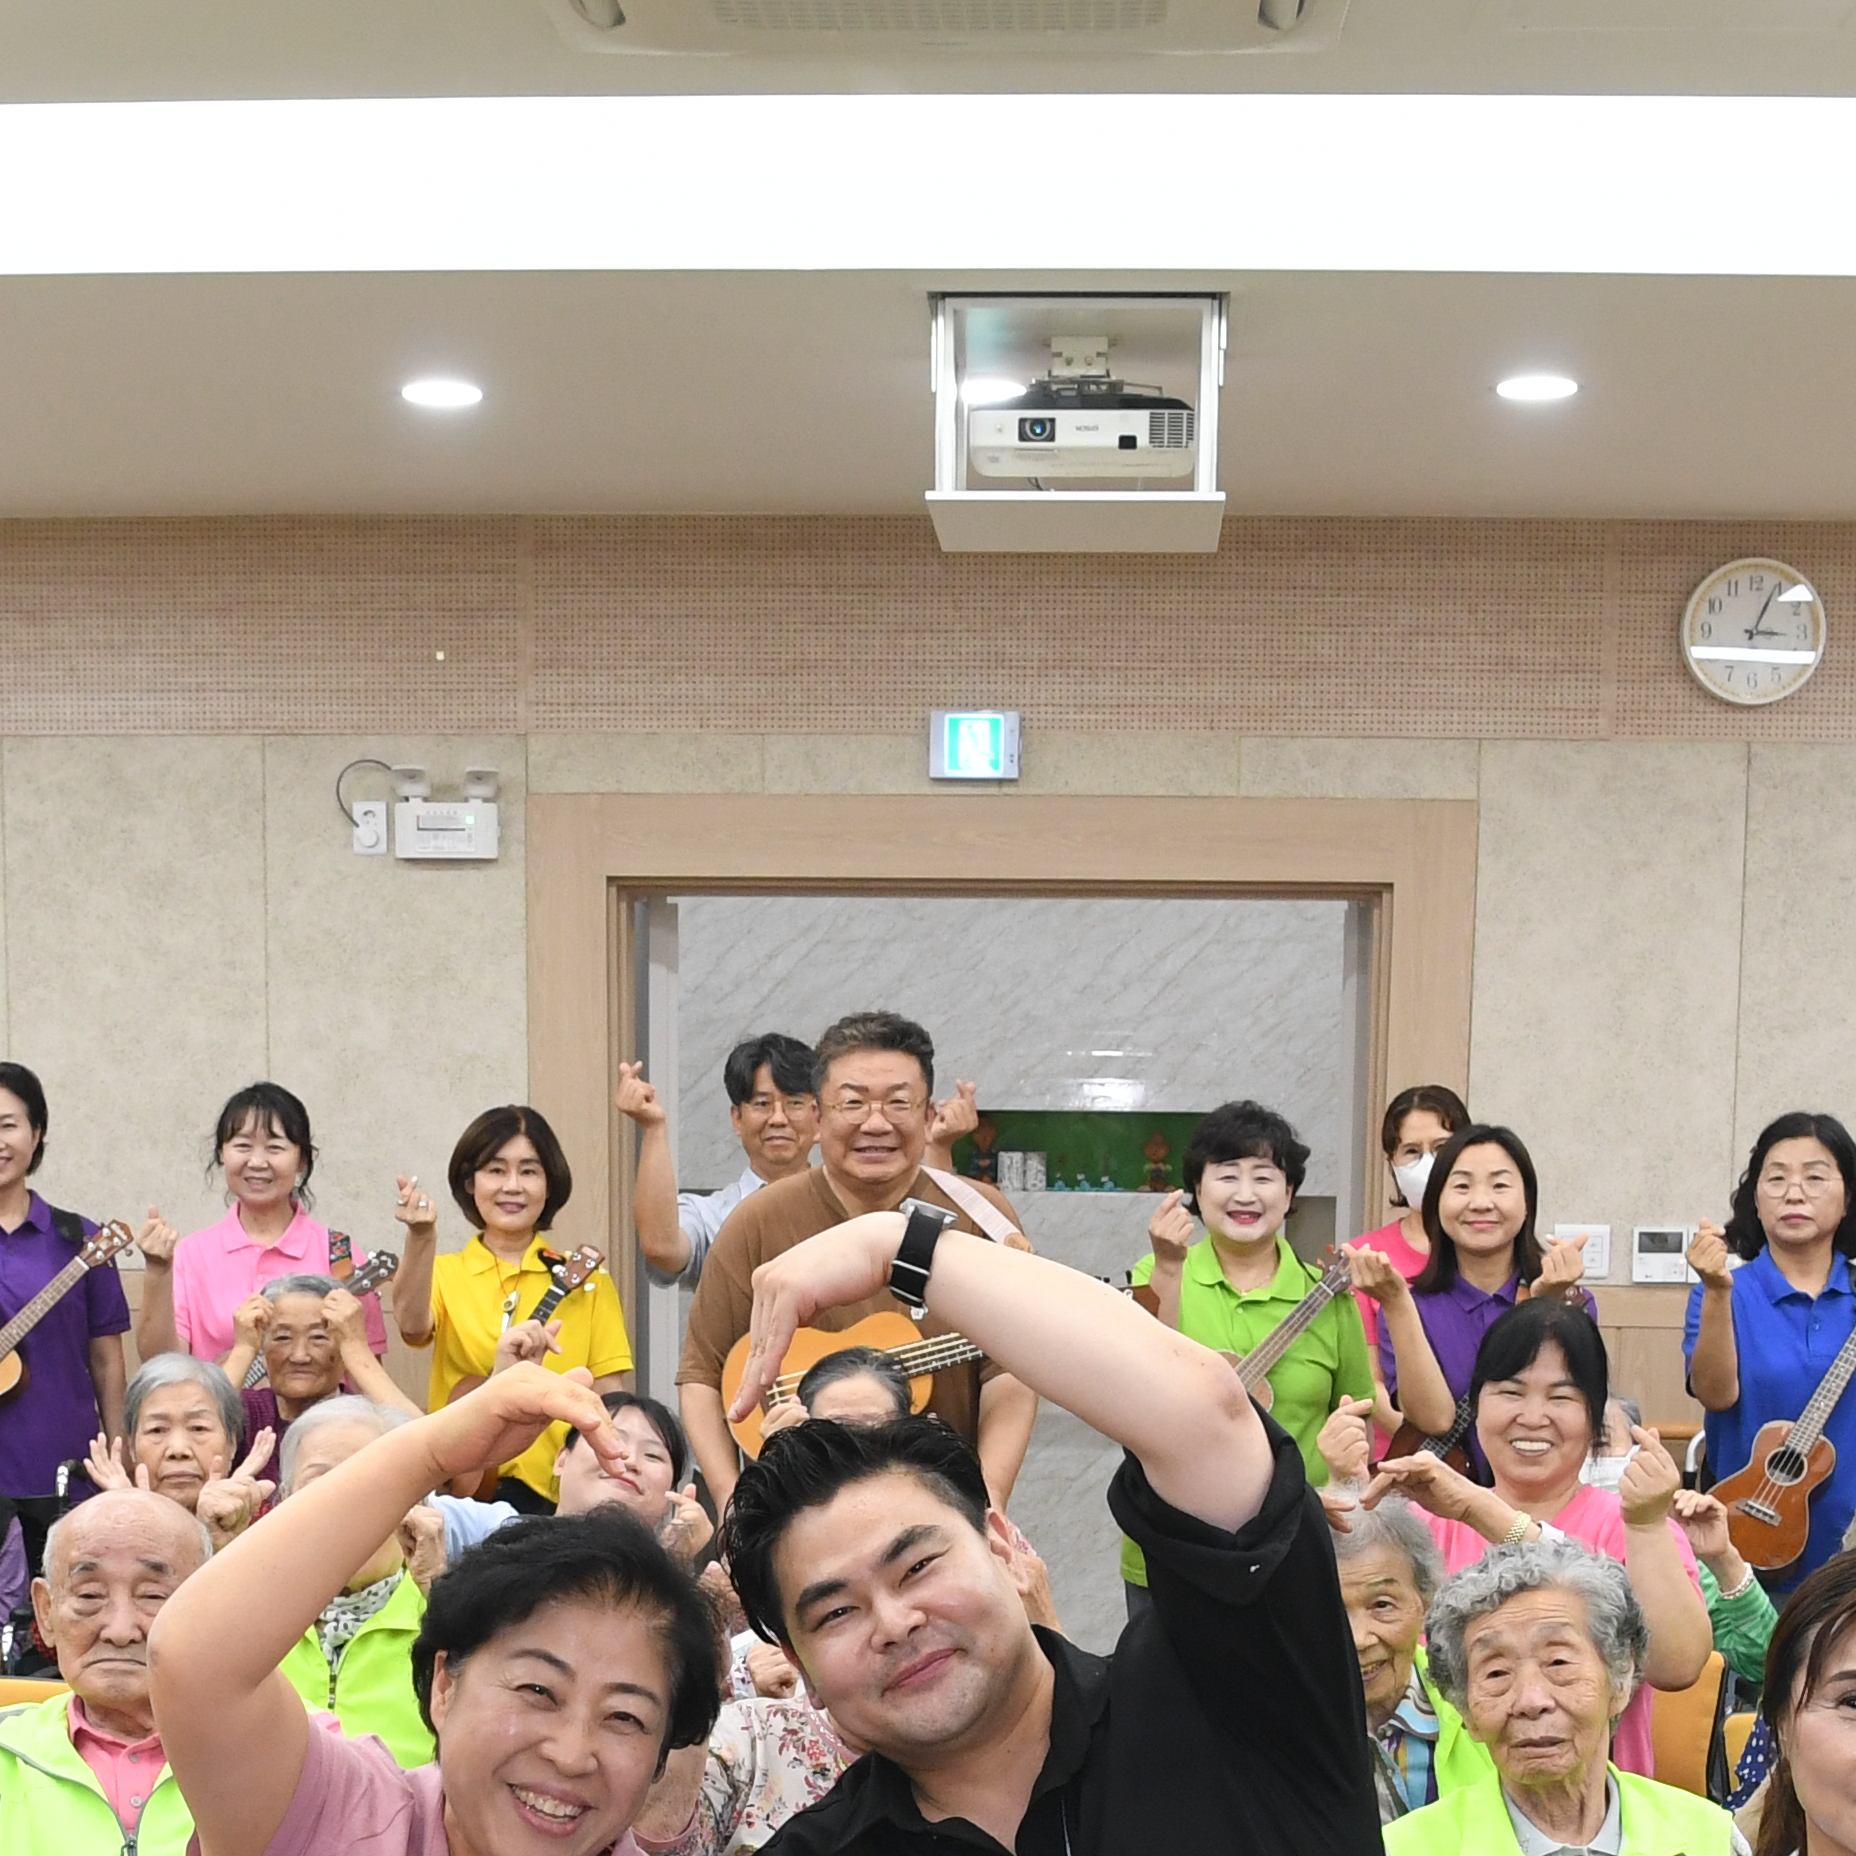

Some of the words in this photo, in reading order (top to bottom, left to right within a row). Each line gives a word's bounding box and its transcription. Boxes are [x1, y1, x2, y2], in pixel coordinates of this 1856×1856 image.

[1726, 579, 1739, 597] 11
[1749, 575, 1764, 592] 12
[1708, 596, 1723, 615] 10
[1700, 621, 1712, 639] 9
[1796, 622, 1808, 641] 3
[1724, 665, 1734, 682] 7
[1746, 672, 1758, 689] 6
[1771, 666, 1782, 683] 5
